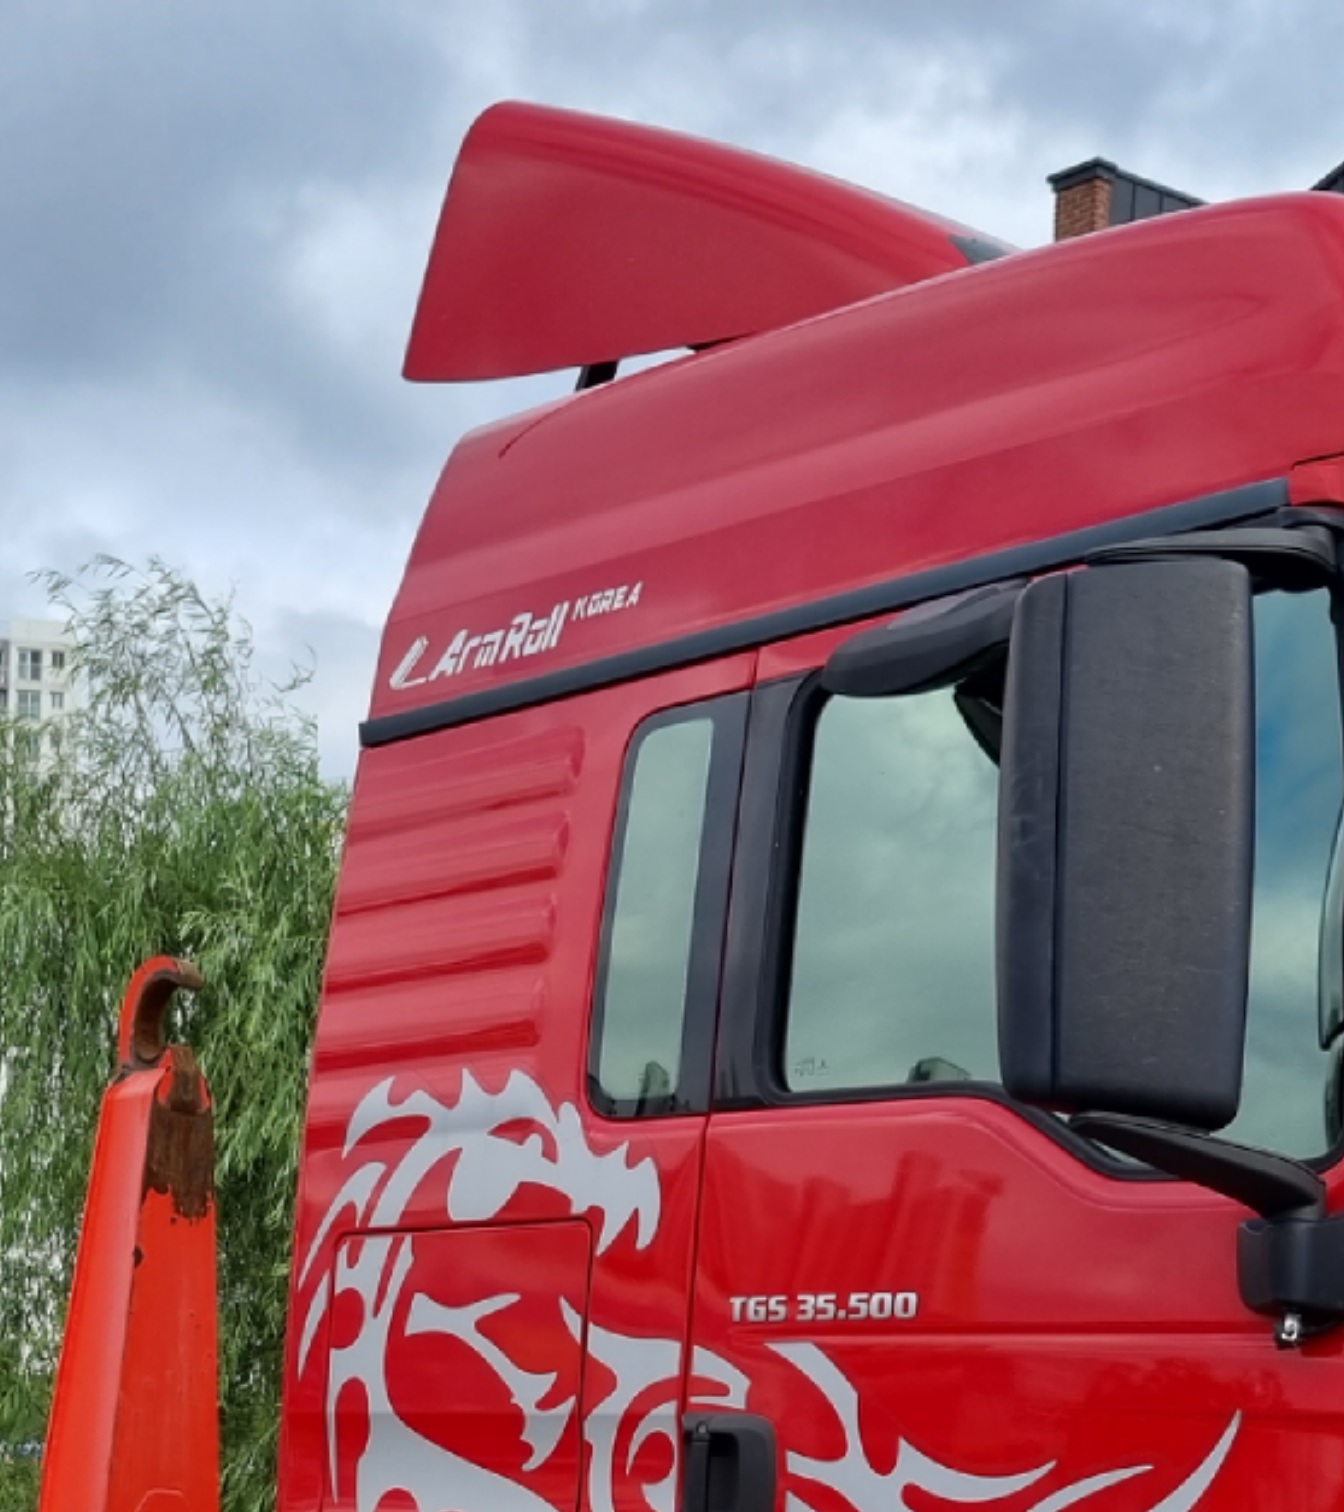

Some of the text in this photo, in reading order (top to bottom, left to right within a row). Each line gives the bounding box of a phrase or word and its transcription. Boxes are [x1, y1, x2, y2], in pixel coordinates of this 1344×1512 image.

[571, 581, 644, 622] KOREA
[729, 1291, 919, 1323] TGS 35.500
